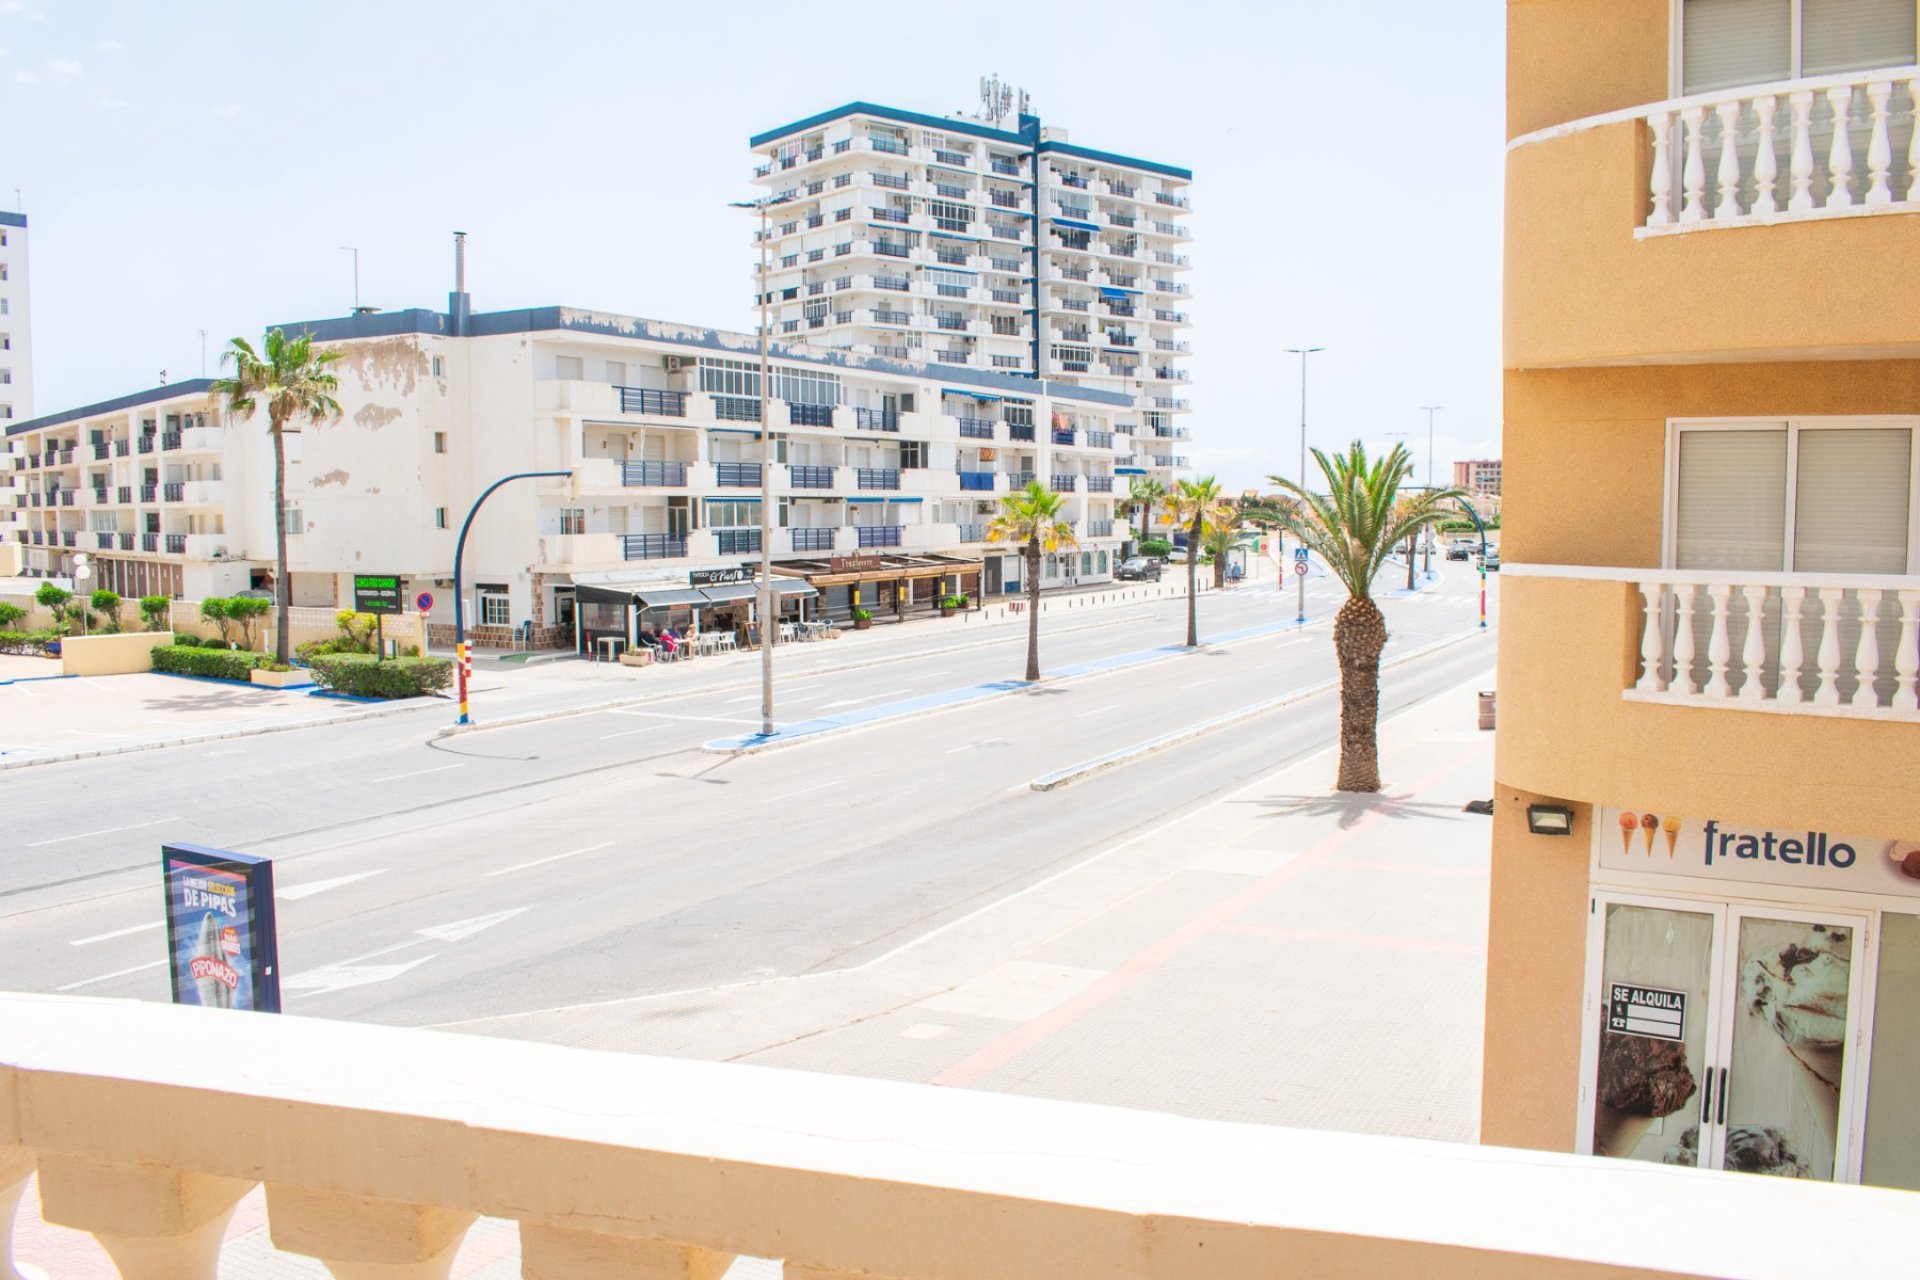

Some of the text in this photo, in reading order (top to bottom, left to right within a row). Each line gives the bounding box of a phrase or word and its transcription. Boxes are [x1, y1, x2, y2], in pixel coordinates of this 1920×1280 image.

[1703, 820, 1856, 868] fratello
[184, 888, 237, 918] DE PIPAS
[191, 959, 237, 988] PIPONAZO
[1613, 987, 1682, 1010] SE ALQUILA
